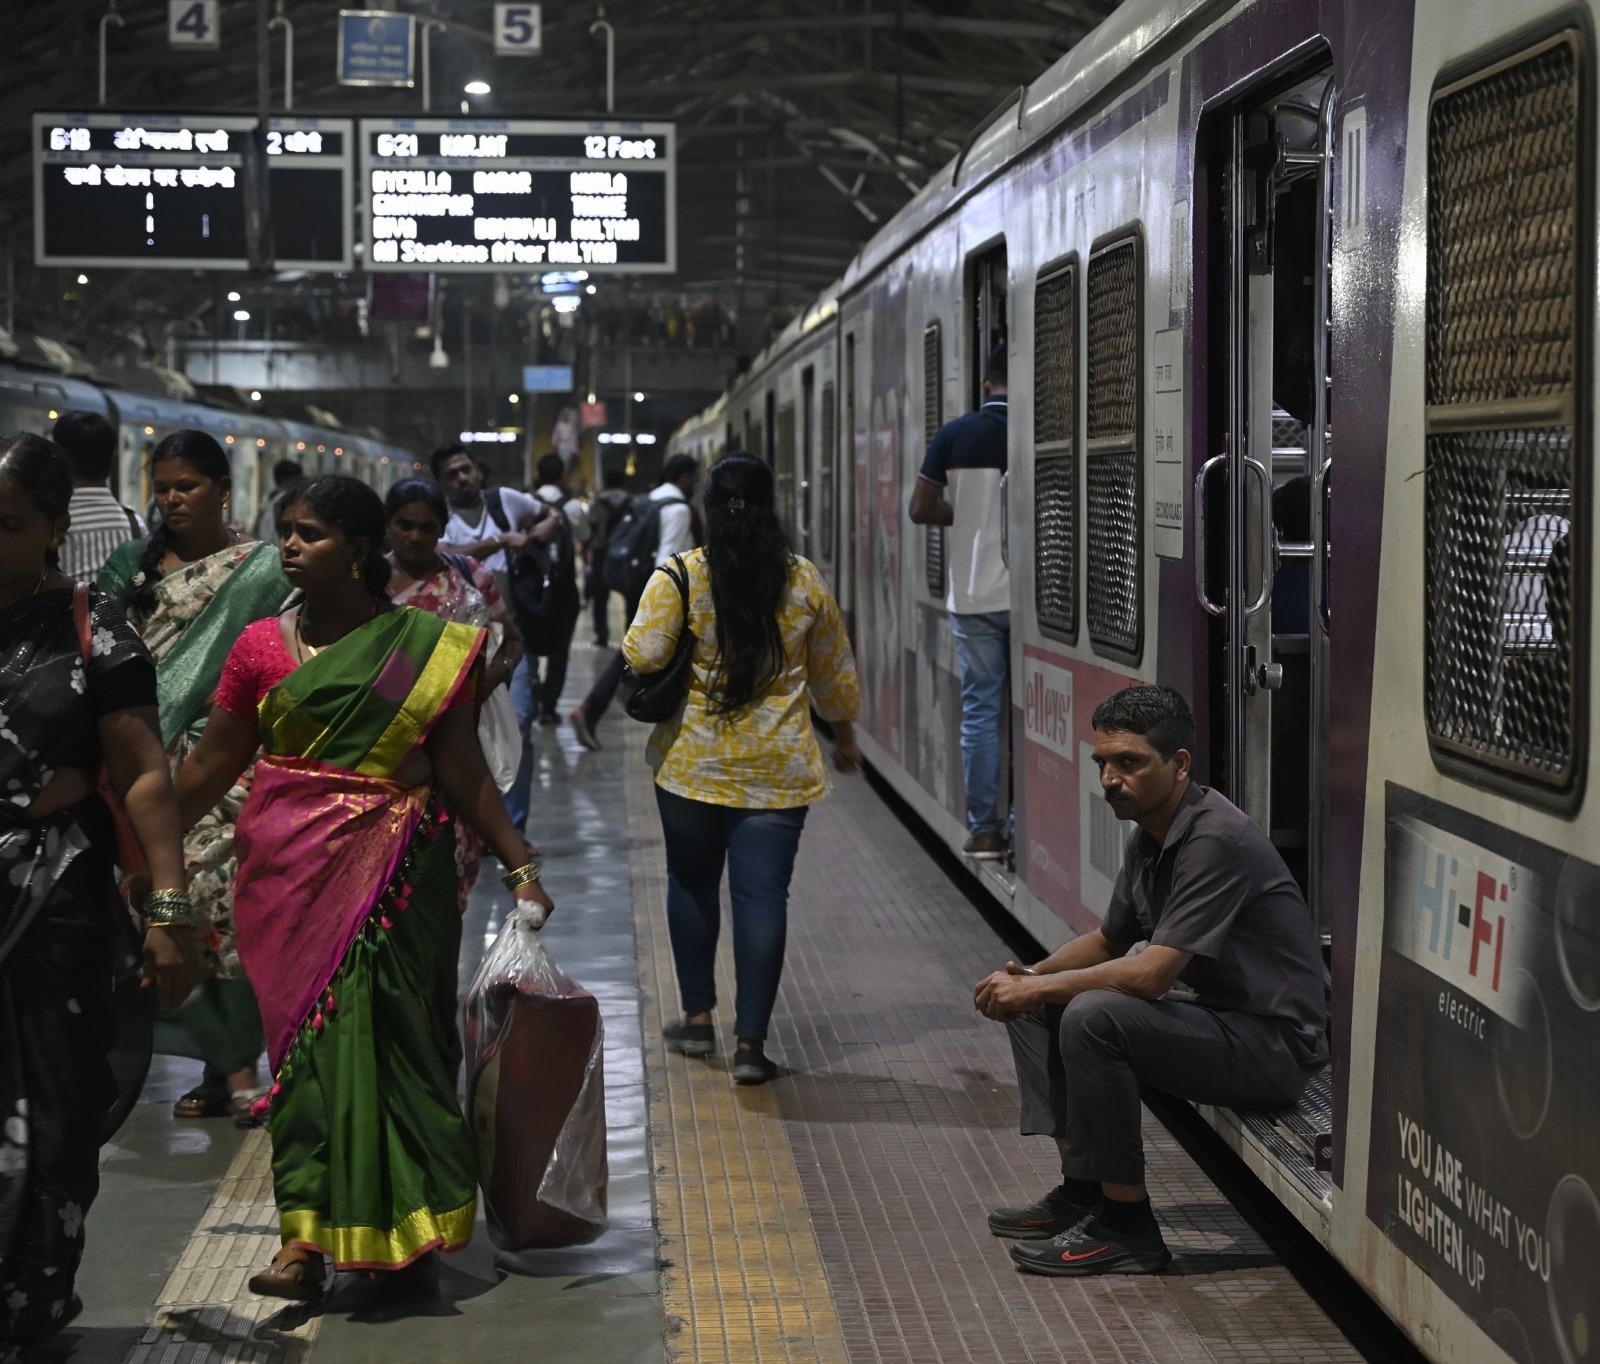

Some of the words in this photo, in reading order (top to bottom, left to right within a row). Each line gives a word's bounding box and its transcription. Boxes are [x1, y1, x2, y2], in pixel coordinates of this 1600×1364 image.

[177, 3, 209, 39] 4
[503, 9, 534, 44] 5
[377, 134, 418, 156] 6:21
[584, 136, 607, 158] 12
[1155, 501, 1170, 519] SECOND
[1170, 502, 1182, 521] CLASS
[1412, 846, 1509, 992] Hi-Fi
[1438, 991, 1485, 1040] electric
[1398, 1111, 1432, 1179] YOU
[1434, 1143, 1463, 1210] ARE
[1465, 1176, 1512, 1250] WHAT
[1515, 1216, 1550, 1283] YOU
[1398, 1173, 1463, 1276] LIGHTEN
[1466, 1244, 1486, 1293] UP
